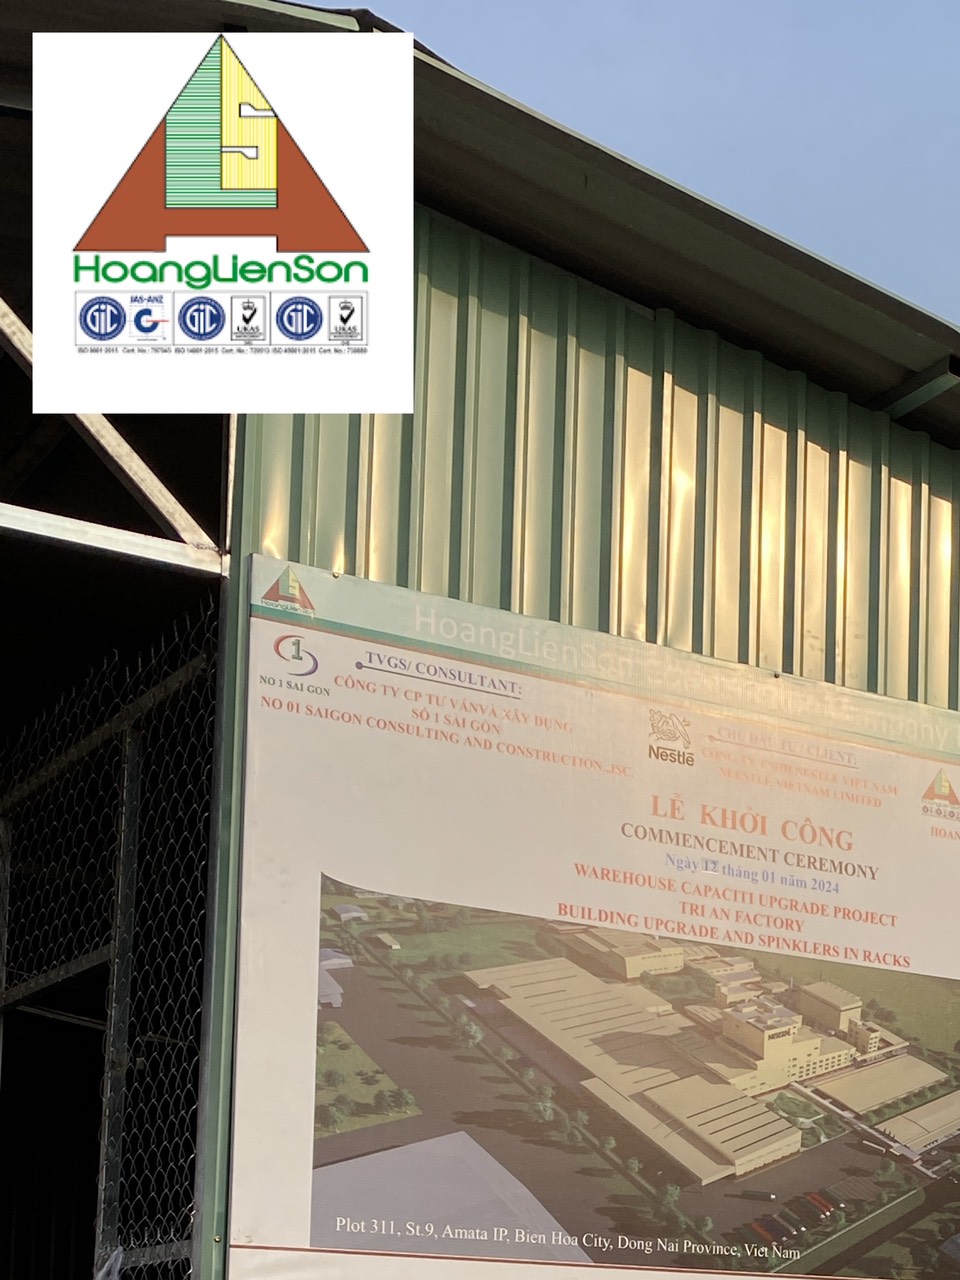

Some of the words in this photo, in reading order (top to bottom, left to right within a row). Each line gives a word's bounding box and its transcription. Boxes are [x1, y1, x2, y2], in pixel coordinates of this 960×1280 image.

[259, 675, 275, 686] NO
[278, 679, 283, 688] 1
[287, 681, 304, 692] SAI
[307, 685, 330, 696] GON
[334, 674, 376, 693] CÔNG
[380, 684, 400, 697] TY
[404, 689, 422, 702] CP
[365, 651, 412, 671] TVGS/
[415, 661, 522, 695] CONSULTANT:
[261, 695, 283, 710] NO
[286, 700, 301, 713] 01
[305, 704, 362, 725] SAIGON
[366, 716, 459, 744] CONSULTING
[463, 736, 492, 750] AND
[700, 805, 768, 836] KHỞI
[781, 817, 854, 852] CÔNG
[620, 822, 779, 863] COMMENCEMENT
[783, 851, 879, 881] CEREMONY
[664, 853, 700, 873] Ngày
[703, 858, 719, 871] 12
[722, 864, 759, 883] tháng
[762, 869, 776, 883] 01
[780, 874, 808, 888] năm
[811, 878, 840, 894] 2024
[574, 863, 677, 893] WAREHOUSE
[681, 881, 754, 905] CAPACITI
[758, 893, 829, 917] UPGRADE
[833, 906, 897, 928] PROJECT
[679, 901, 706, 917] TRI
[710, 908, 730, 921] AN
[735, 910, 805, 932] FACTORY
[557, 902, 639, 928] BUILDING
[644, 915, 718, 940] UPGRADE
[723, 929, 754, 946] AND
[758, 934, 840, 959] SPINKLERS
[844, 948, 860, 961] IN
[863, 949, 911, 968] RACKS
[335, 1217, 366, 1233] Plot
[370, 1219, 401, 1237] 311,
[405, 1221, 438, 1239] St.9,
[442, 1225, 488, 1241] Amata
[493, 1227, 510, 1243] IP,
[514, 1229, 546, 1244] Bien
[551, 1232, 578, 1247] Hoa
[582, 1233, 613, 1251] City,
[617, 1235, 653, 1254] Dong
[657, 1238, 679, 1252] Nai
[683, 1241, 741, 1257] Province,
[772, 1246, 800, 1259] Nam
